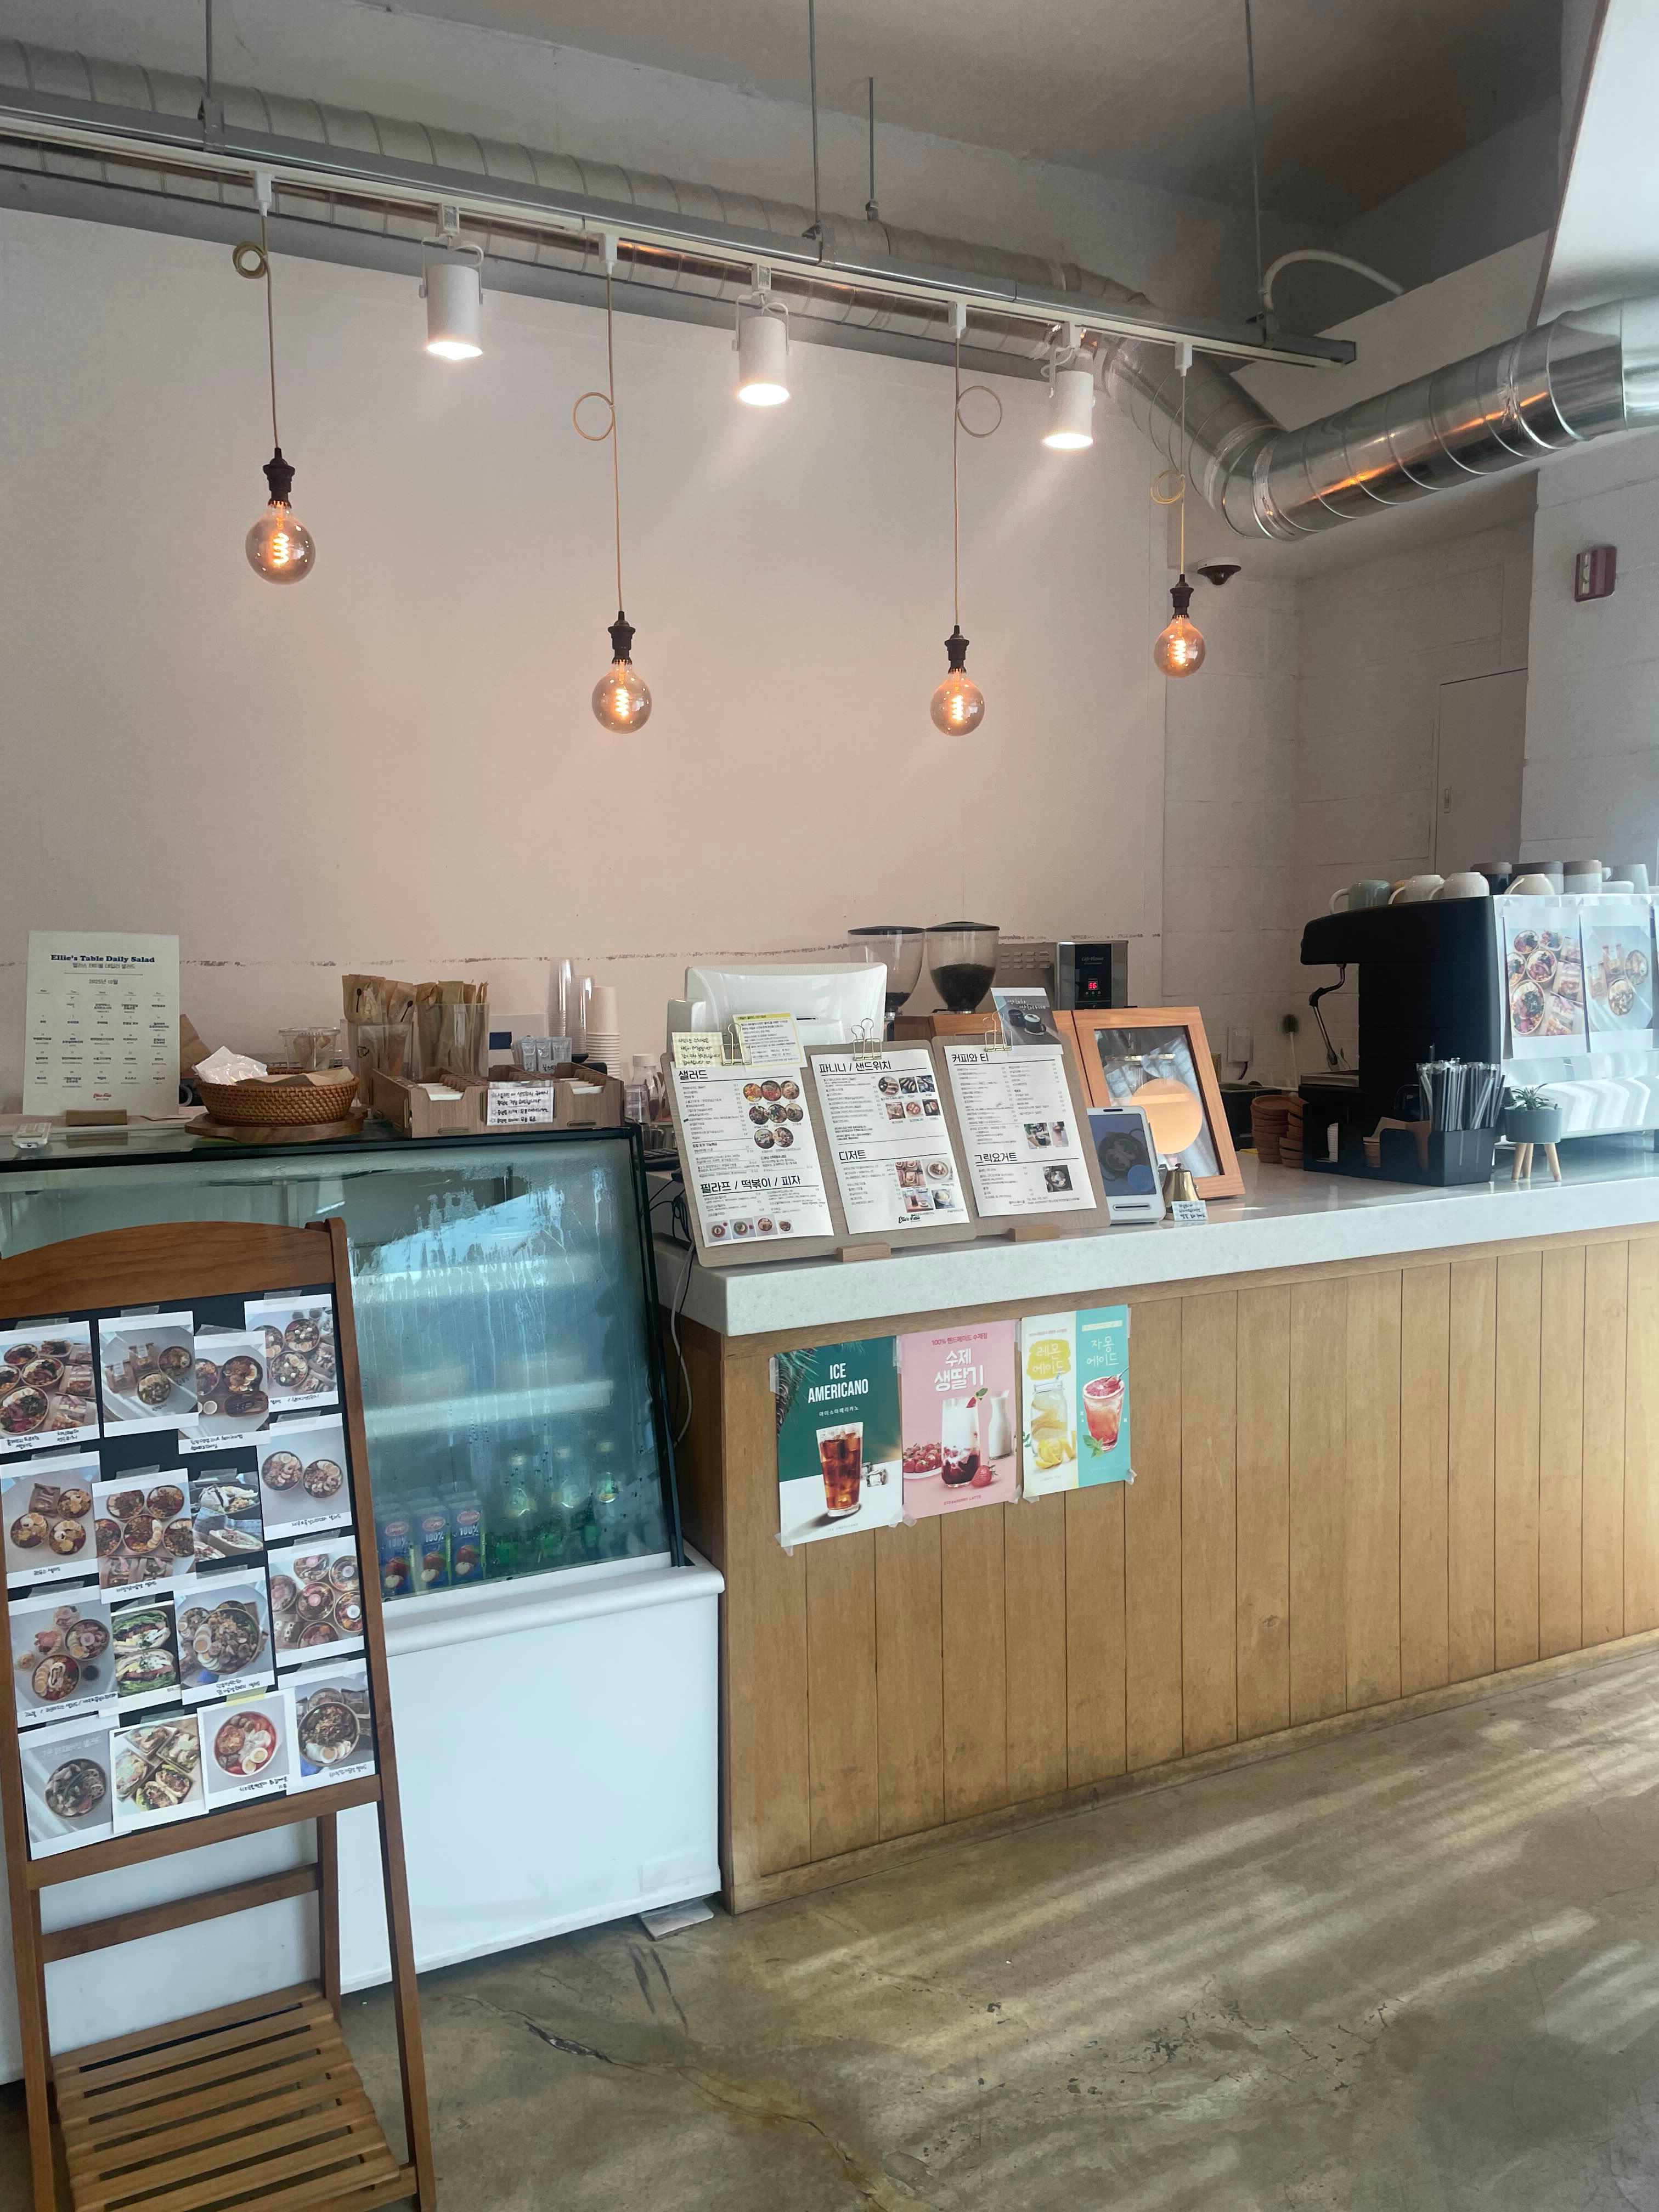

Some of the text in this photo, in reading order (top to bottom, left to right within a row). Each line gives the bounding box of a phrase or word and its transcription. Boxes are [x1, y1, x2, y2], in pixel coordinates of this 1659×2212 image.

[951, 1053, 989, 1063] 커피와 티
[819, 1063, 847, 1073] 파니니
[855, 1060, 891, 1071] 샌드위치
[679, 1070, 708, 1080] 샐러드
[838, 1150, 867, 1161] 디저트
[974, 1152, 1018, 1164] 그릭요거트
[701, 1181, 731, 1194] 필라프
[741, 1177, 771, 1189] 떡볶이
[781, 1175, 801, 1186] 피자
[1036, 1343, 1062, 1359] 레몬
[1090, 1336, 1115, 1352] 자몽
[945, 1348, 972, 1367] 수제
[1086, 1352, 1119, 1367] 에이드
[830, 1363, 847, 1380] ICE
[1032, 1361, 1066, 1374] 에이드
[934, 1364, 984, 1392] 생딸기
[808, 1378, 868, 1403] AMERICANO
[459, 1522, 479, 1536] 100%
[425, 1531, 444, 1543] 100%
